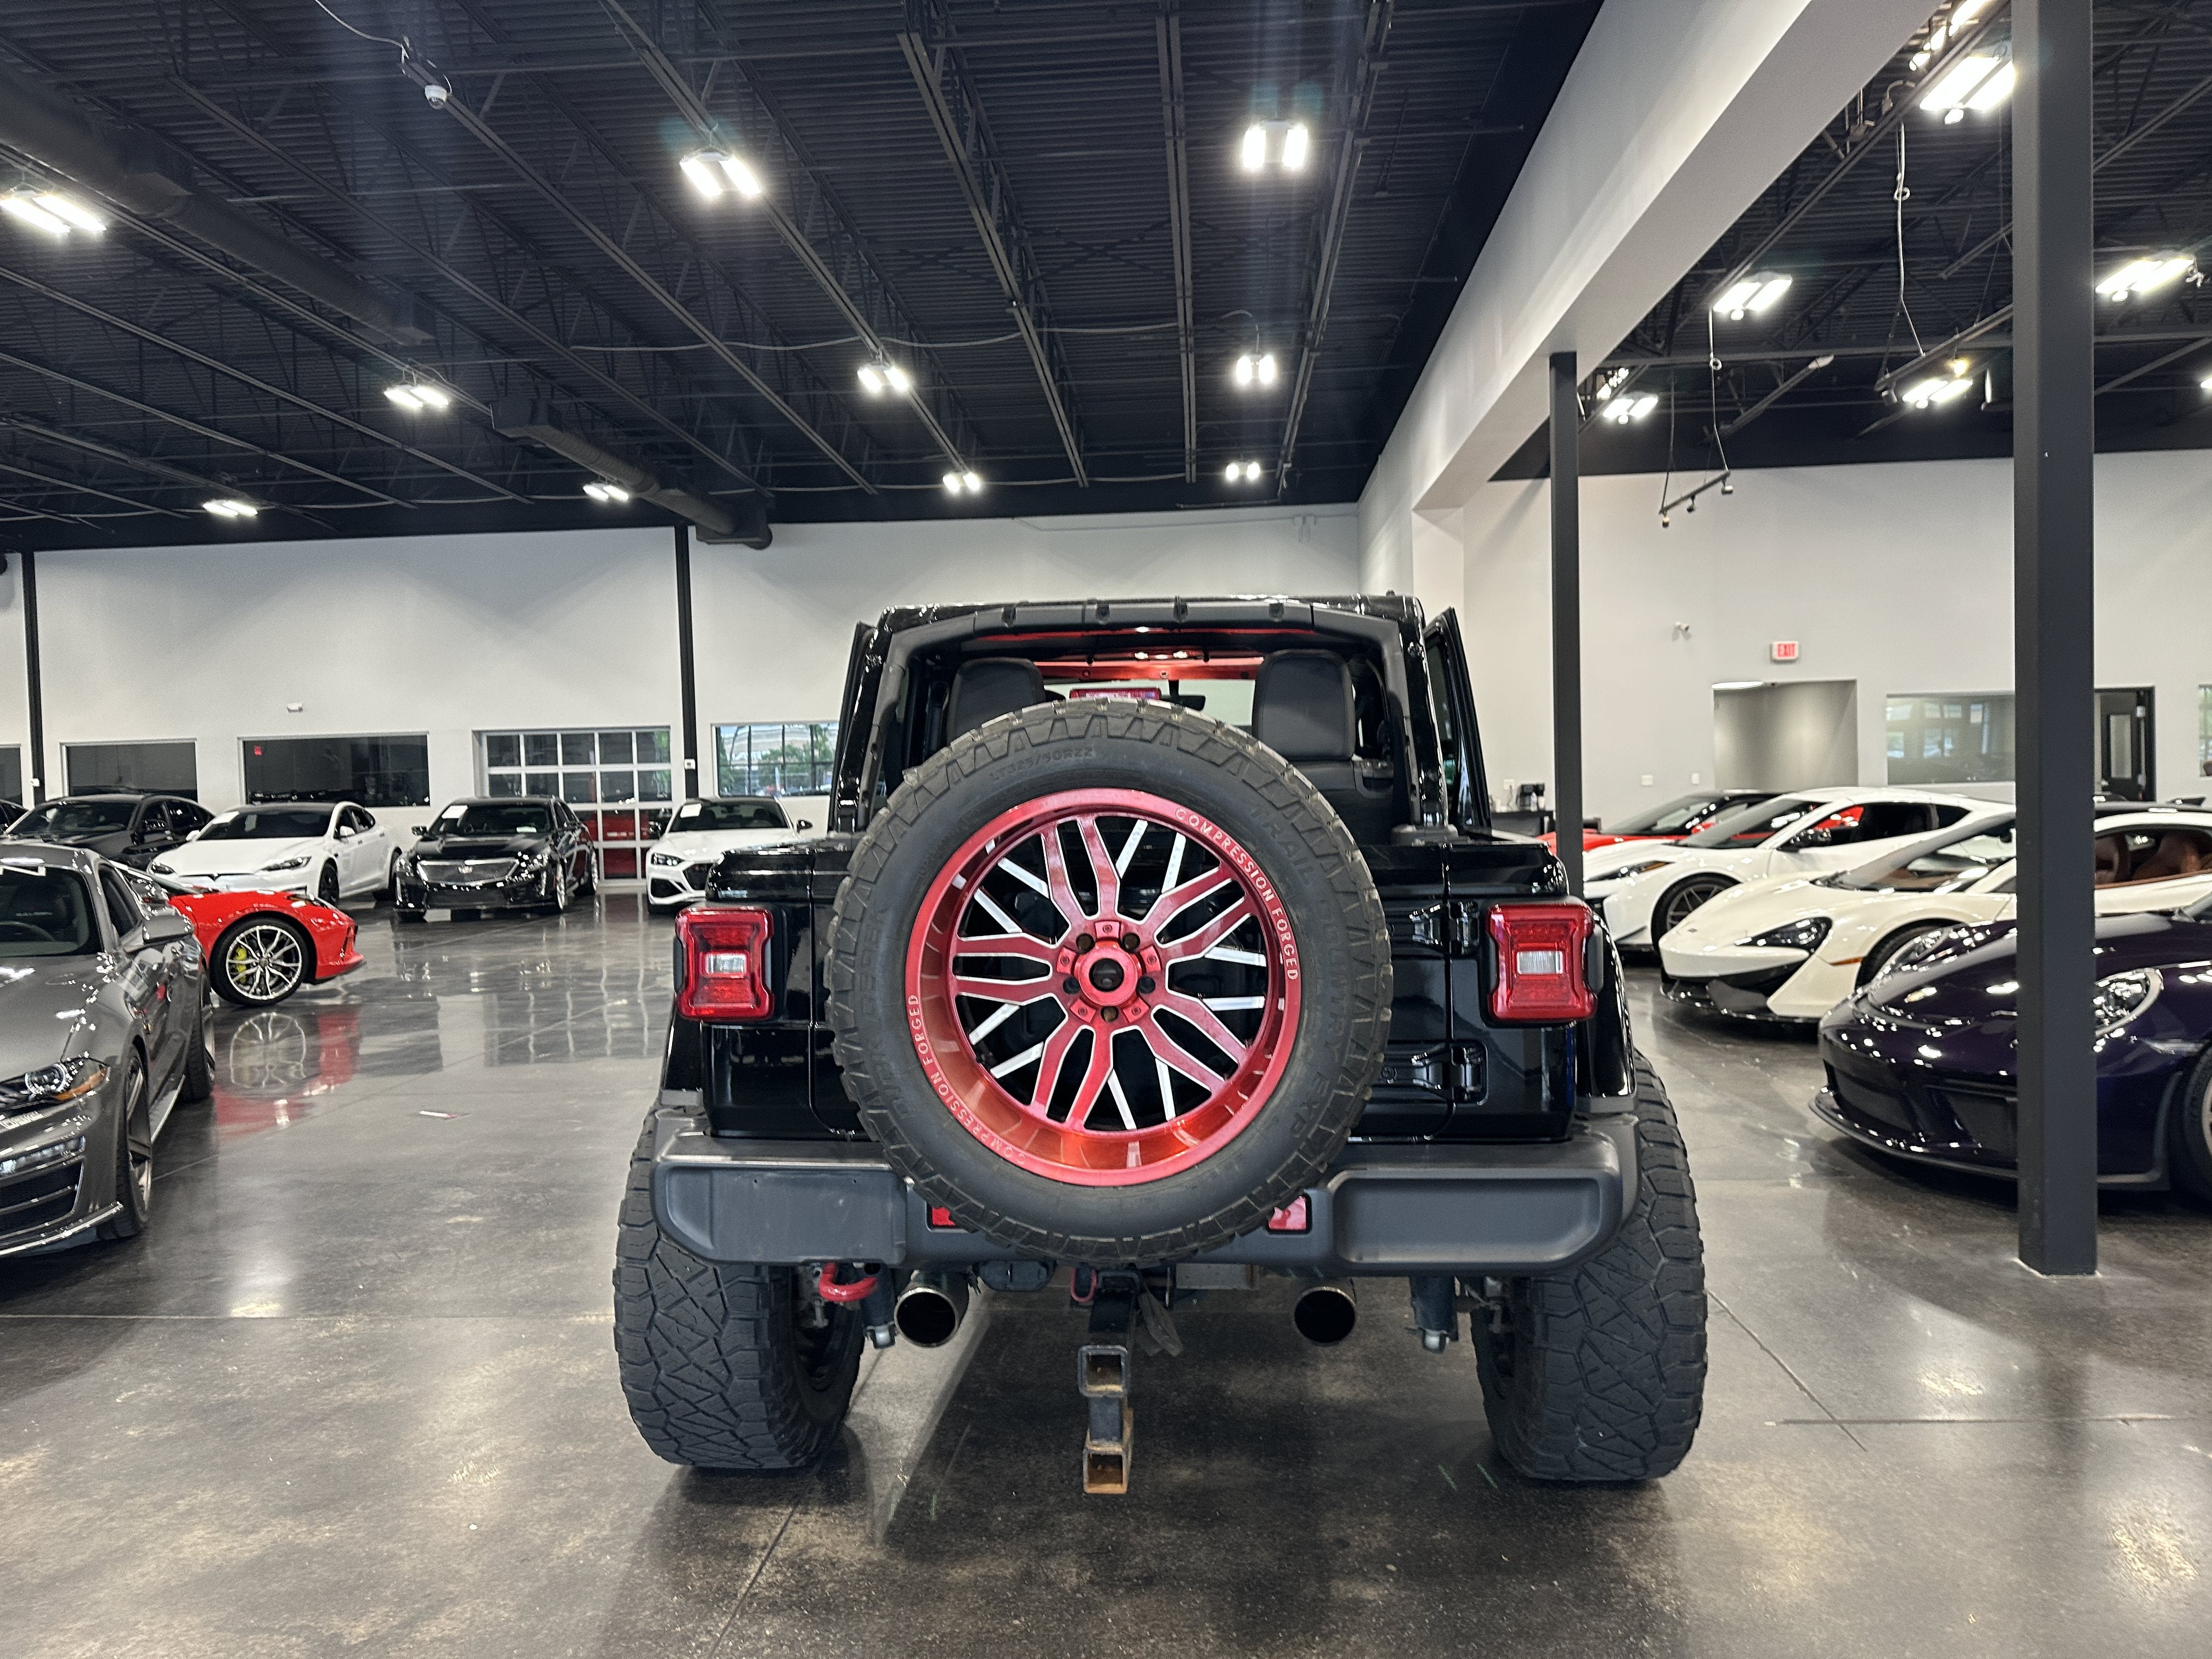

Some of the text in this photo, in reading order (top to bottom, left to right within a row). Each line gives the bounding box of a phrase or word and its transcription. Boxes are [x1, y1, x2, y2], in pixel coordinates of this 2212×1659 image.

[1778, 644, 1795, 657] EXIT
[1175, 807, 1299, 980] COMPRESSION FORGED
[907, 994, 1027, 1165] COMPRESSION FORGED
